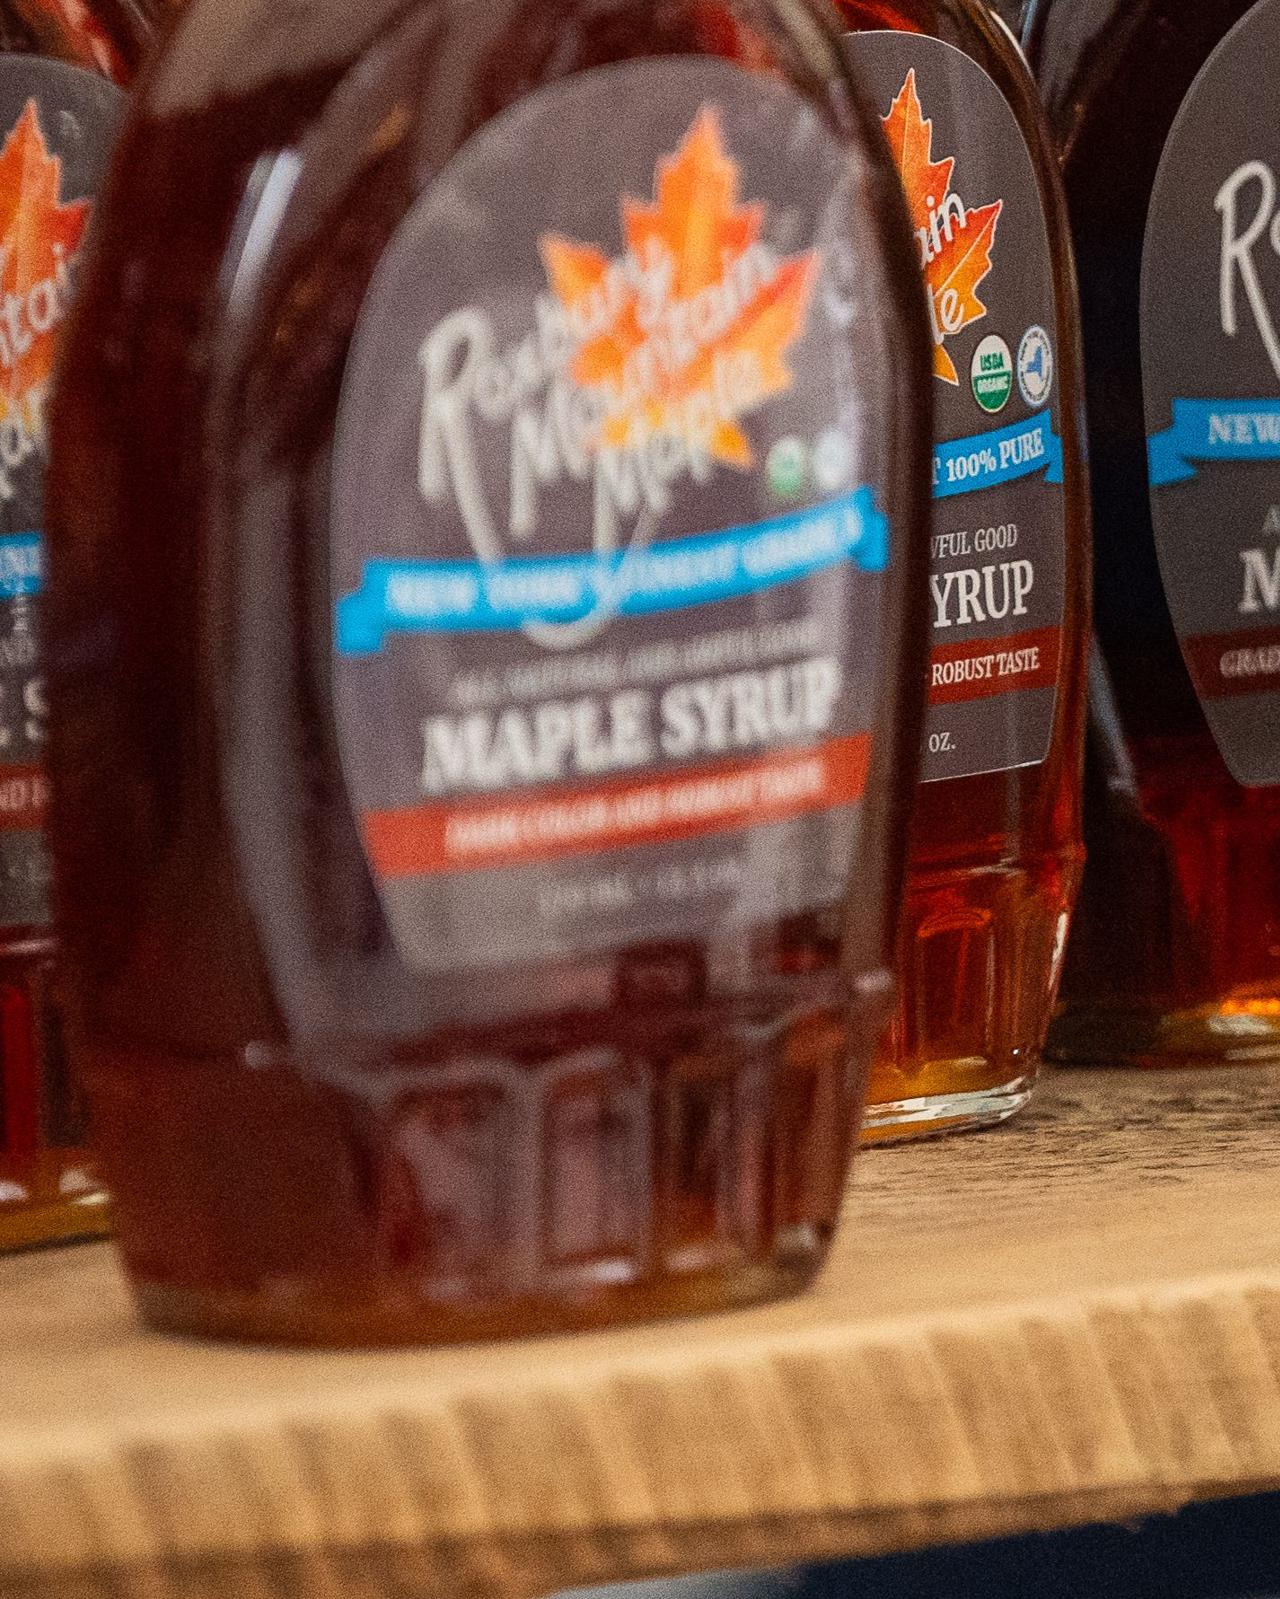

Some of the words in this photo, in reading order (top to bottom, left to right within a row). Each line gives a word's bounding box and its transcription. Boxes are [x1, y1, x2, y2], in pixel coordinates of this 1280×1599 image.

[980, 352, 1004, 371] USDA
[946, 448, 997, 482] 100%
[998, 427, 1045, 469] PURE
[931, 531, 971, 558] FUL
[974, 523, 1018, 552] GOOD
[930, 559, 1034, 629] YRUP
[931, 654, 995, 686] ROBUST
[996, 646, 1040, 676] TASTE
[421, 690, 654, 796] MAPLE
[660, 656, 844, 760] SYRUP
